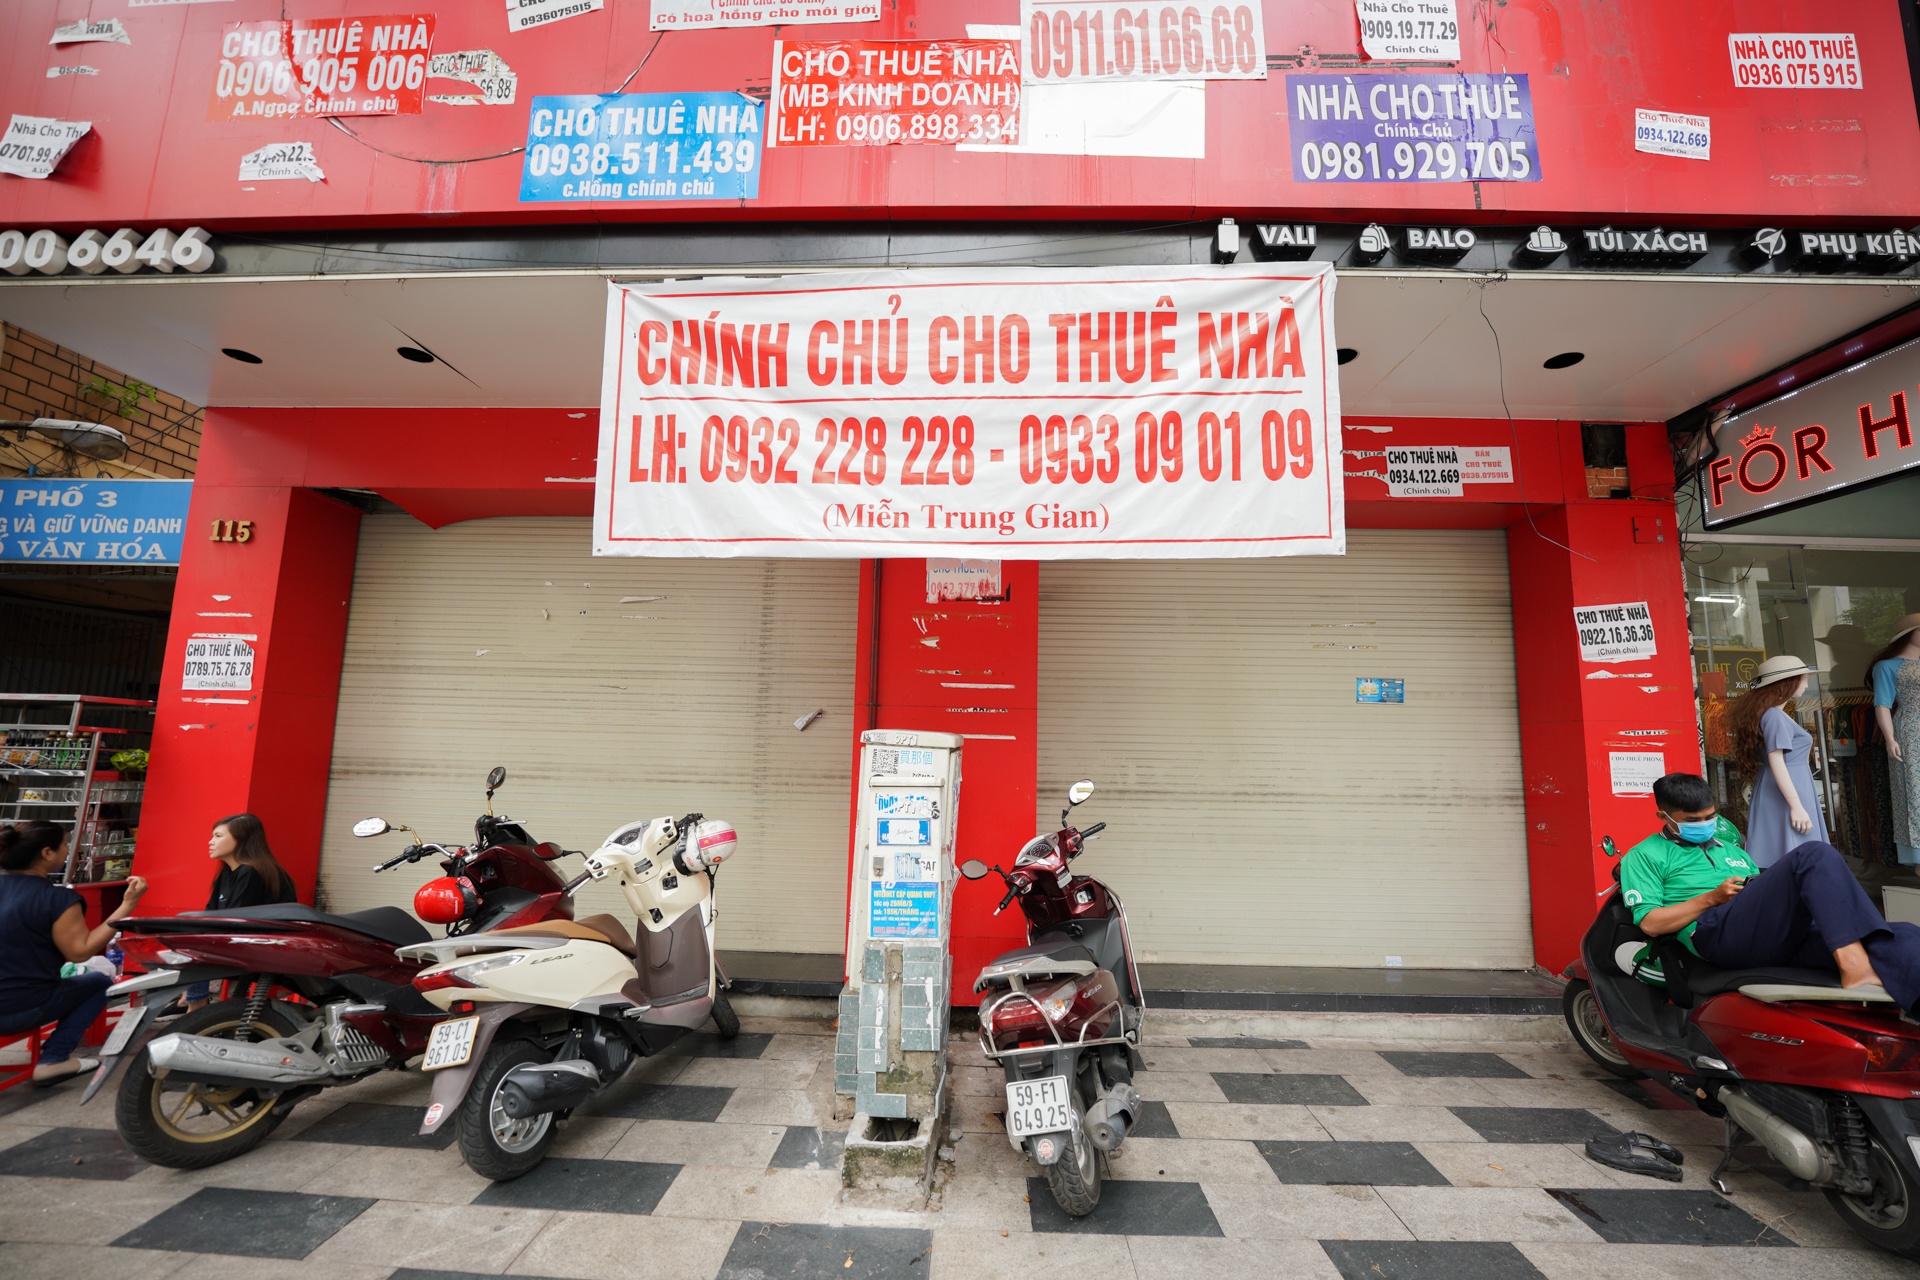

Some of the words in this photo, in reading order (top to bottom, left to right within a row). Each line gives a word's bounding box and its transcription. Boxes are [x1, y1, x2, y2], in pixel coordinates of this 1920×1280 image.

[520, 2, 592, 26] 0936075915
[656, 12, 677, 24] Có
[683, 13, 714, 23] hoa
[720, 8, 762, 22] hồng
[768, 9, 799, 18] cho
[806, 6, 838, 17] môi
[845, 4, 877, 17] giới
[1363, 1, 1388, 13] Nhà
[1391, 2, 1415, 13] Cho
[1417, 2, 1449, 14] Thuê
[223, 30, 281, 58] CHO
[291, 22, 363, 55] THUÊ
[371, 18, 428, 51] NHÀ
[1031, 4, 1255, 79] 0911.61.66.68
[1361, 18, 1458, 41] 0909.19.77.29
[782, 50, 850, 77] CHO
[860, 44, 943, 77] THUÊ
[953, 41, 1020, 77] NHÀ
[1734, 36, 1769, 60] NHÀ
[1772, 40, 1807, 60] CHO
[1809, 35, 1856, 60] THUÊ
[216, 60, 292, 97] 0906
[301, 56, 358, 94] 905
[367, 53, 425, 92] 006
[1738, 63, 1782, 86] 0936
[1786, 63, 1820, 86] 075
[1825, 63, 1858, 86] 915
[779, 83, 829, 109] (MB
[838, 83, 903, 107] KINH
[910, 83, 1021, 108] DOANH)
[1296, 77, 1364, 121] NHÀ
[1369, 83, 1435, 121] CHO
[1439, 76, 1522, 120] THUÊ
[533, 107, 596, 138] CHO
[606, 100, 687, 136] THUÊ
[778, 119, 826, 143] LH:
[836, 114, 1018, 142] 0906.898.334
[1638, 112, 1657, 122] Cho
[11, 122, 37, 136] Nhà
[40, 125, 61, 138] Cho
[1374, 122, 1419, 138] Chính
[1422, 122, 1453, 138] Chủ
[1637, 126, 1708, 148] 0934.122.669
[529, 140, 755, 177] 0938.511.439
[1301, 141, 1531, 180] 0981.929.705
[562, 179, 622, 199] c.Hồng
[627, 178, 677, 197] chính
[681, 177, 715, 196] chủ
[67, 227, 204, 268] 6646
[1257, 225, 1317, 246] VALI
[1408, 228, 1476, 248] BALO
[1585, 226, 1623, 251] TÚI
[1631, 226, 1708, 252] XÁCH
[1801, 233, 1857, 260] PHỤ
[638, 310, 788, 388] CHÍNH
[806, 294, 911, 387] CHỦ
[928, 314, 1031, 385] CHO
[1049, 294, 1178, 384] THUÊ
[1198, 295, 1306, 379] NHÀ
[629, 413, 687, 484] LH:
[699, 415, 797, 484] 0932
[813, 416, 887, 486] 228
[900, 416, 975, 486] 228
[1019, 413, 1120, 484] 0933
[1135, 412, 1184, 483] 09
[1198, 410, 1242, 482] 01
[1261, 408, 1313, 482] 09
[1388, 451, 1408, 464] CHO
[1410, 447, 1435, 464] THUÊ
[1437, 447, 1459, 464] NHÀ
[1389, 469, 1460, 484] 0934.122.669
[15, 484, 88, 508] PHỐ
[95, 491, 118, 508] 3
[14, 513, 36, 533] VÀ
[44, 513, 77, 534] GIỮ
[80, 513, 129, 534] VỮNG
[133, 518, 182, 534] DANH
[822, 498, 913, 533] (Miễn
[920, 503, 1018, 536] Trung
[1025, 500, 1110, 534] Gian)
[209, 519, 252, 544] 115
[17, 536, 86, 559] VĂN
[95, 536, 166, 560] HÓA
[1576, 611, 1598, 624] CHO
[1599, 606, 1626, 623] THUÊ
[1626, 604, 1649, 621] NHÀ
[1580, 624, 1653, 646] 0922.16.36.36
[186, 643, 206, 657] CHO
[208, 641, 231, 657] THUÊ
[184, 661, 252, 677] 0789.75.76.78
[530, 953, 574, 965] LEAD
[436, 1020, 470, 1044] 59-C1
[426, 1041, 470, 1066] 961.05
[1015, 1081, 1058, 1107] 59-F1
[1013, 1104, 1068, 1132] 649.25
